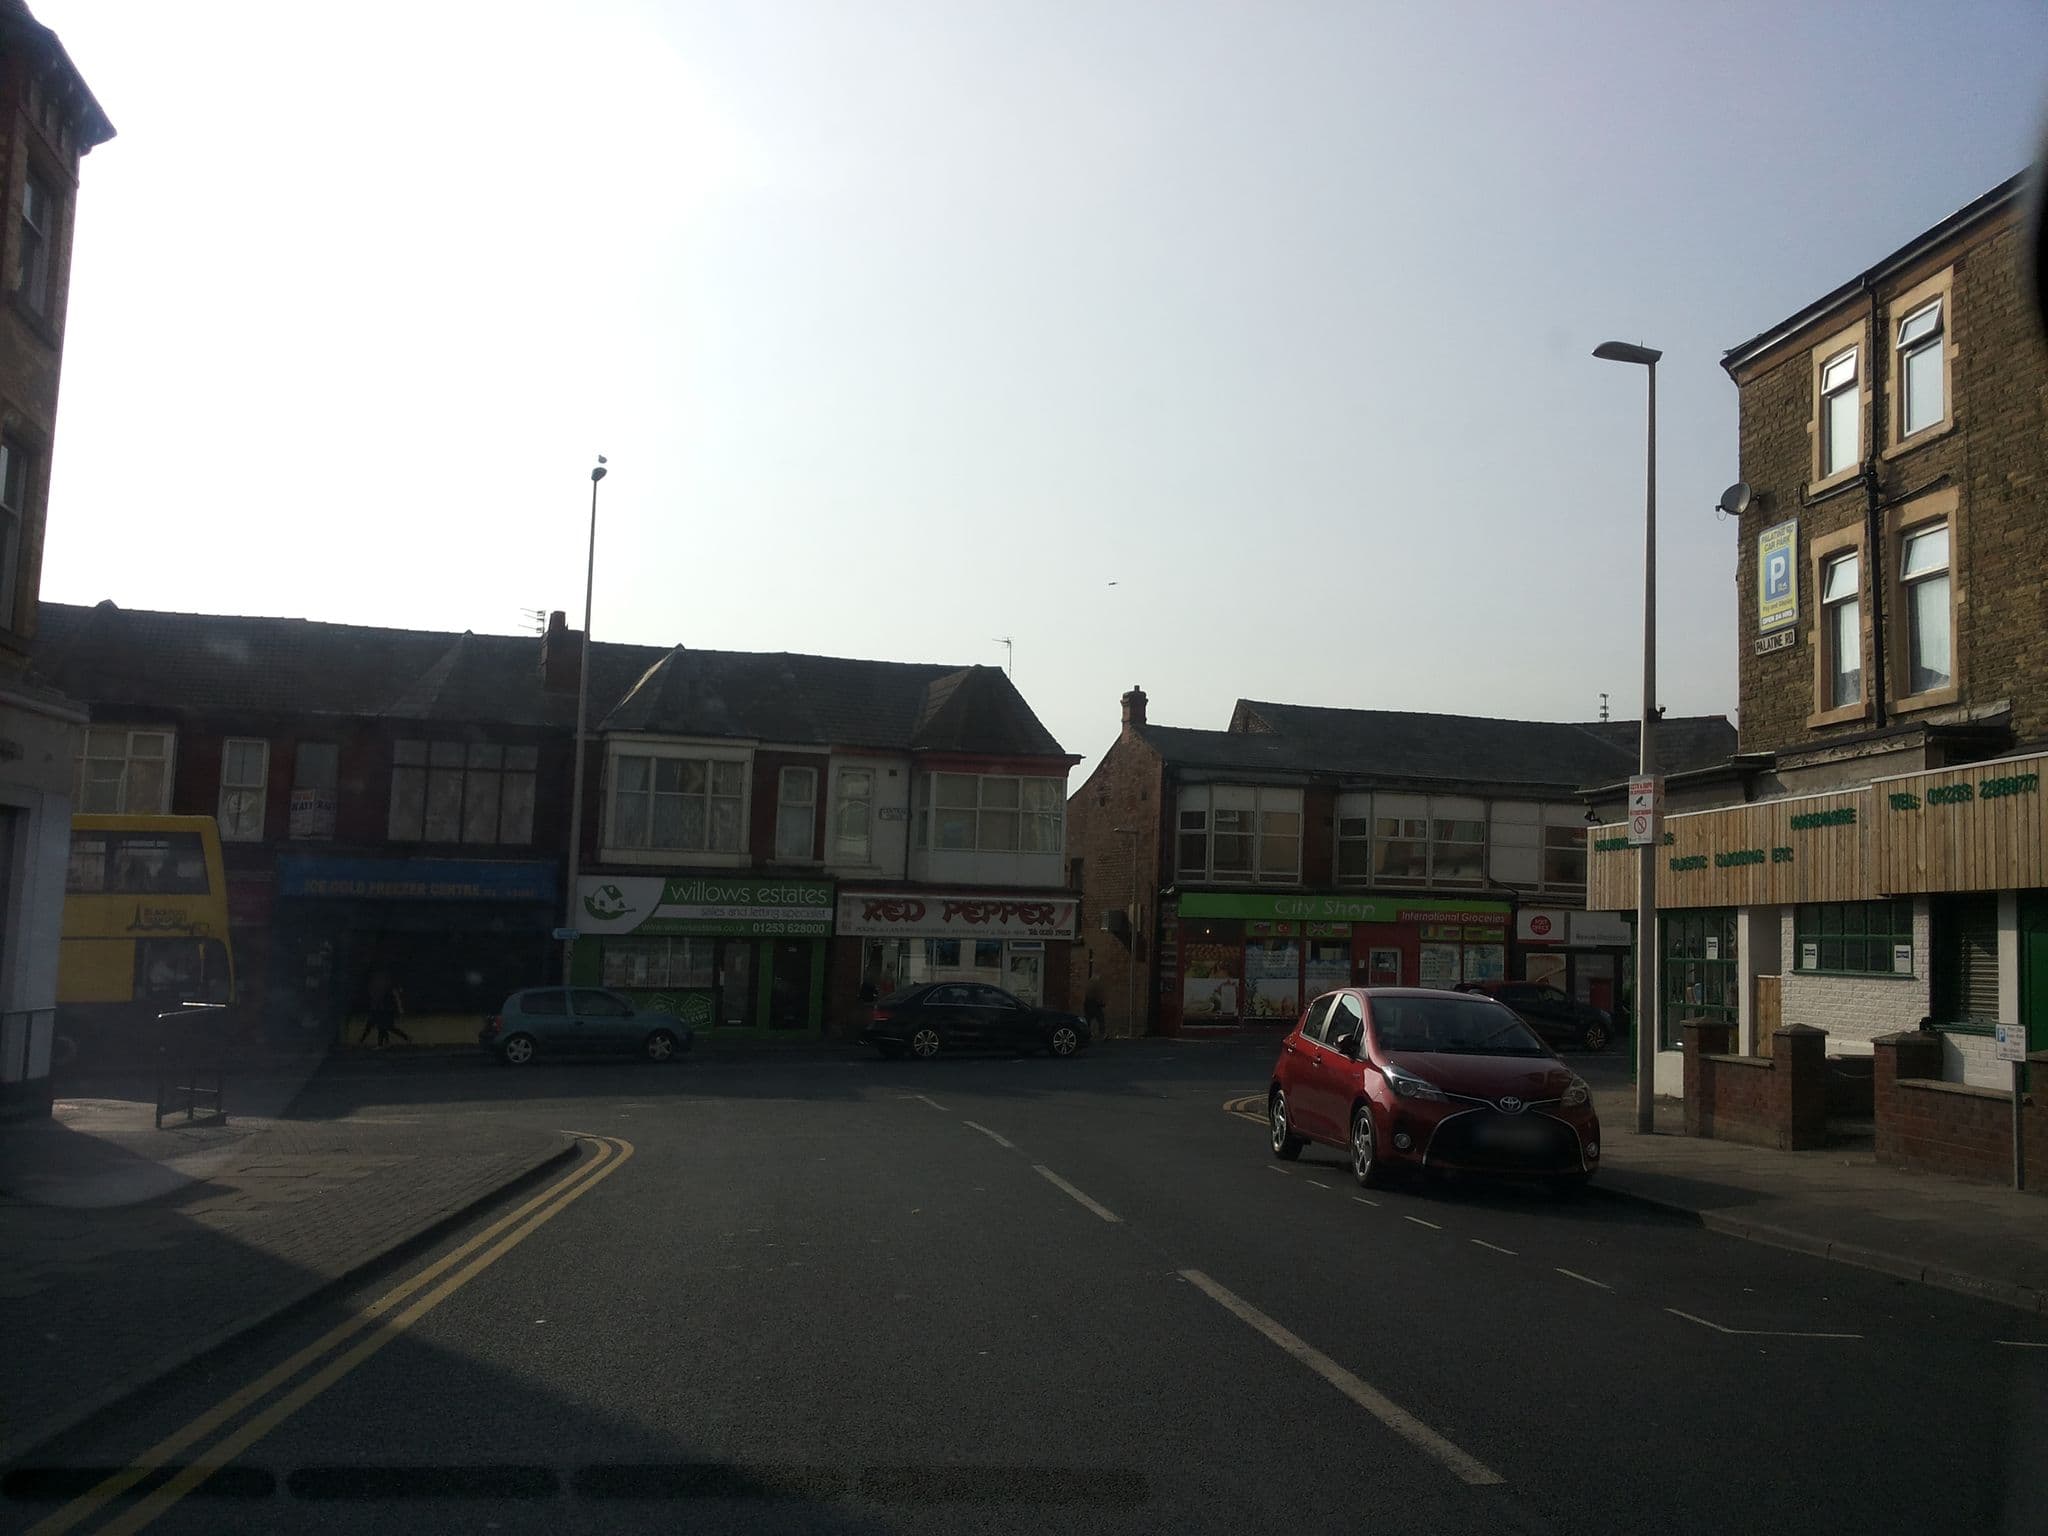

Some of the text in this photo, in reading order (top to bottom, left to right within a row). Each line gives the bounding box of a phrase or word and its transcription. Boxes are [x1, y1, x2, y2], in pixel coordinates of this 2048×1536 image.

[1770, 556, 1786, 595] P
[1756, 631, 1793, 652] PALATINE RD
[670, 880, 827, 905] willows estates
[862, 899, 926, 923] RED
[943, 901, 1056, 926] PEPPER
[1274, 900, 1376, 920] City Shop
[1402, 911, 1505, 924] International Groceries
[753, 922, 785, 934] 01253
[787, 923, 825, 935] 628000
